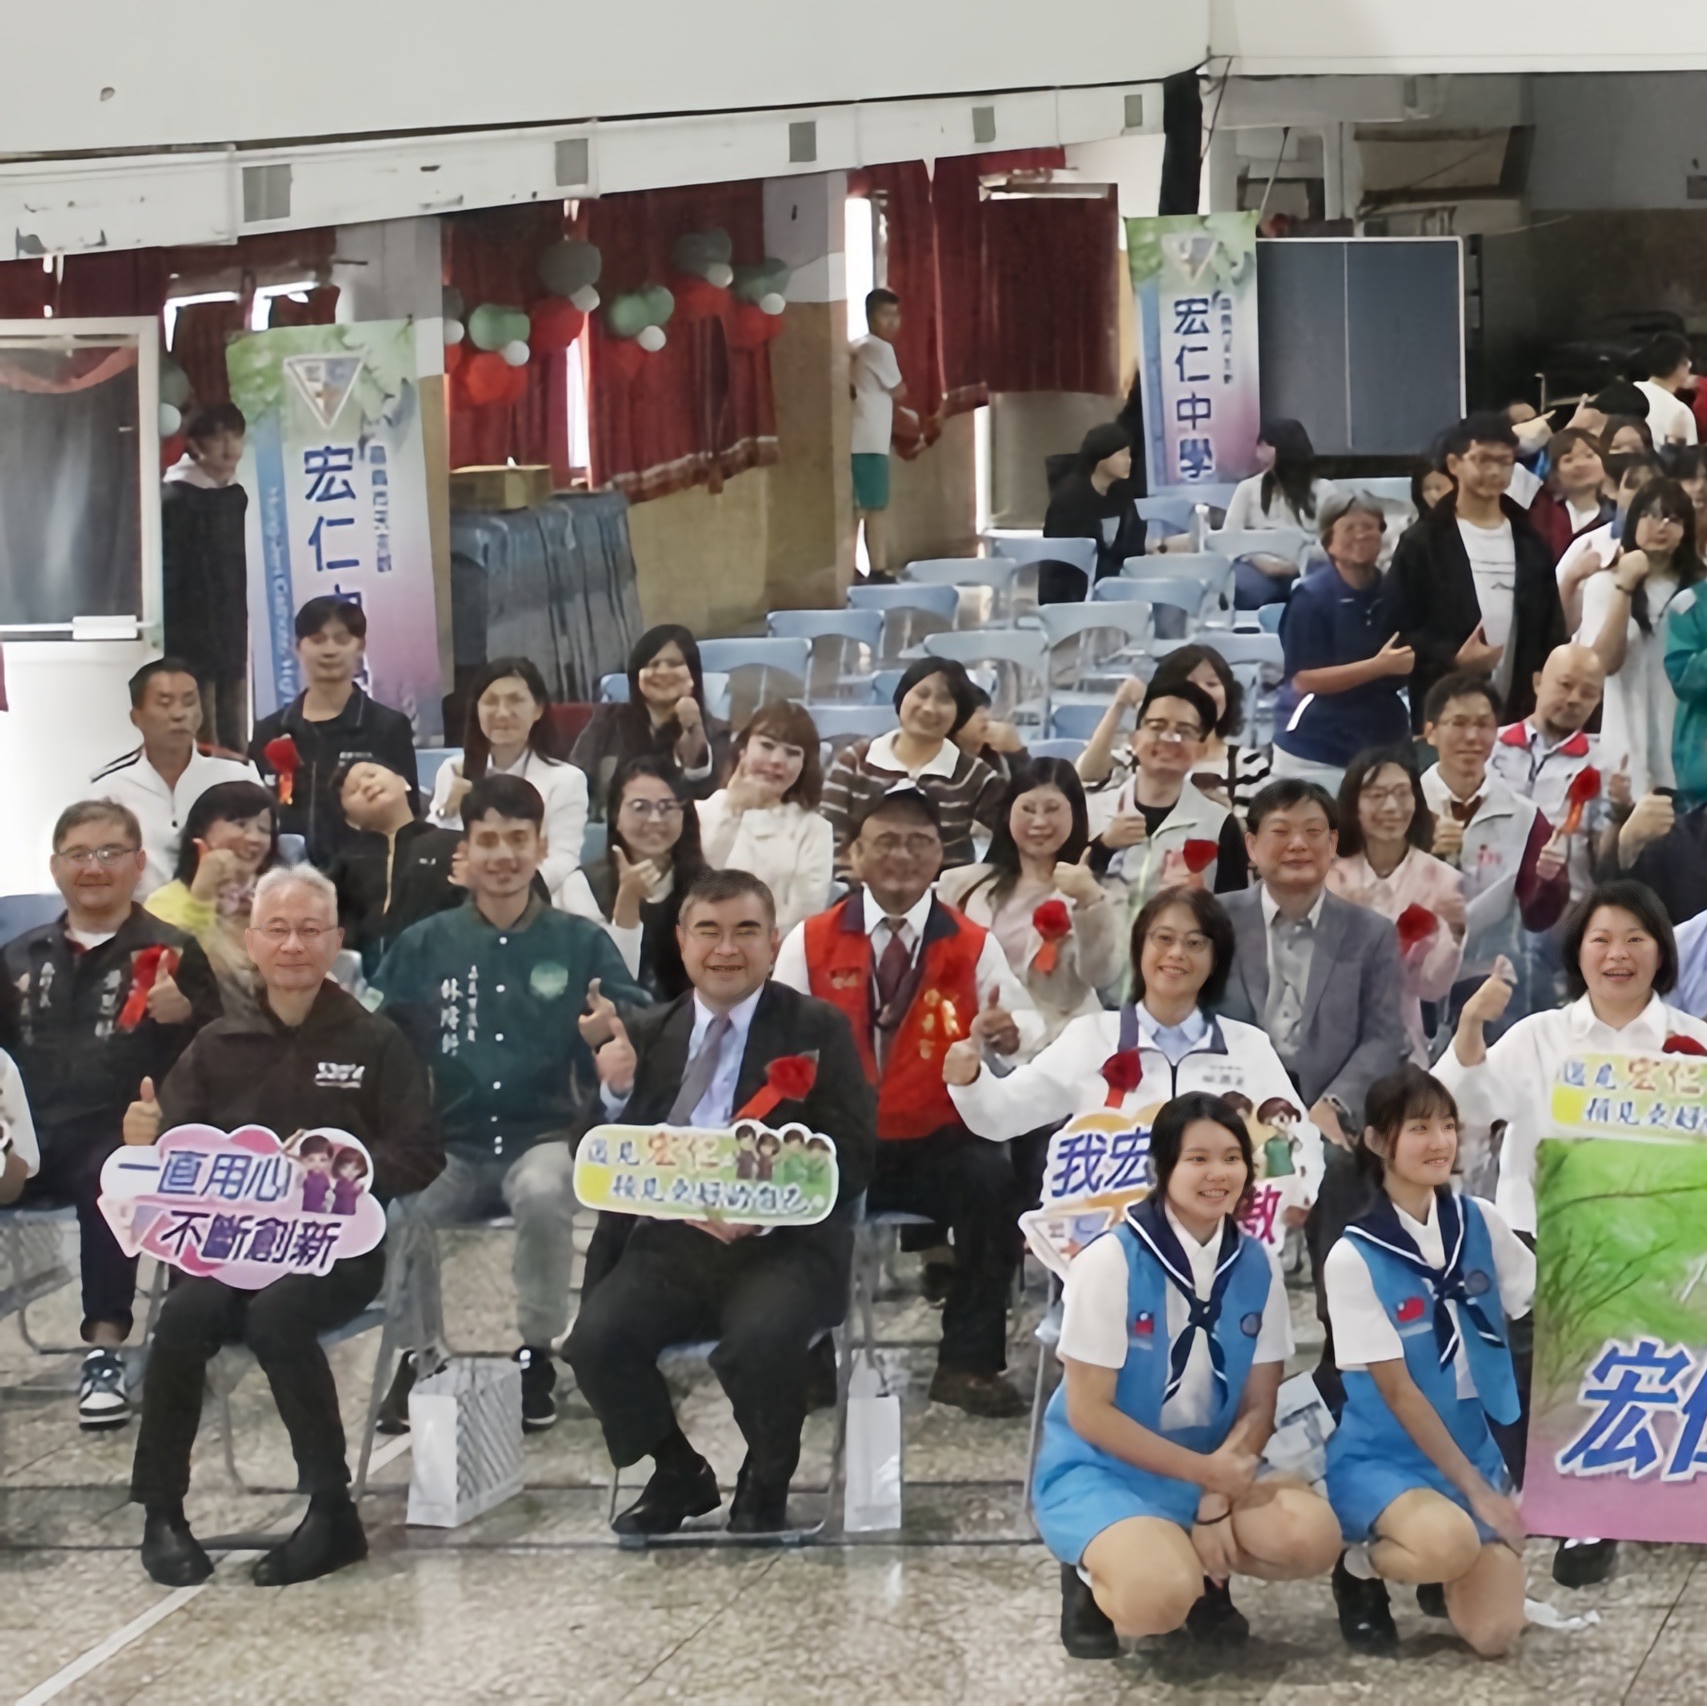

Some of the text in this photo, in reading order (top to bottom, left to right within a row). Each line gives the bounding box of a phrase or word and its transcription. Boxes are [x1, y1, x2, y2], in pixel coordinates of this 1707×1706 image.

[1173, 296, 1215, 483] 宏仁中學
[118, 1150, 294, 1202] 一直用心
[160, 1209, 342, 1268] 不斷創新
